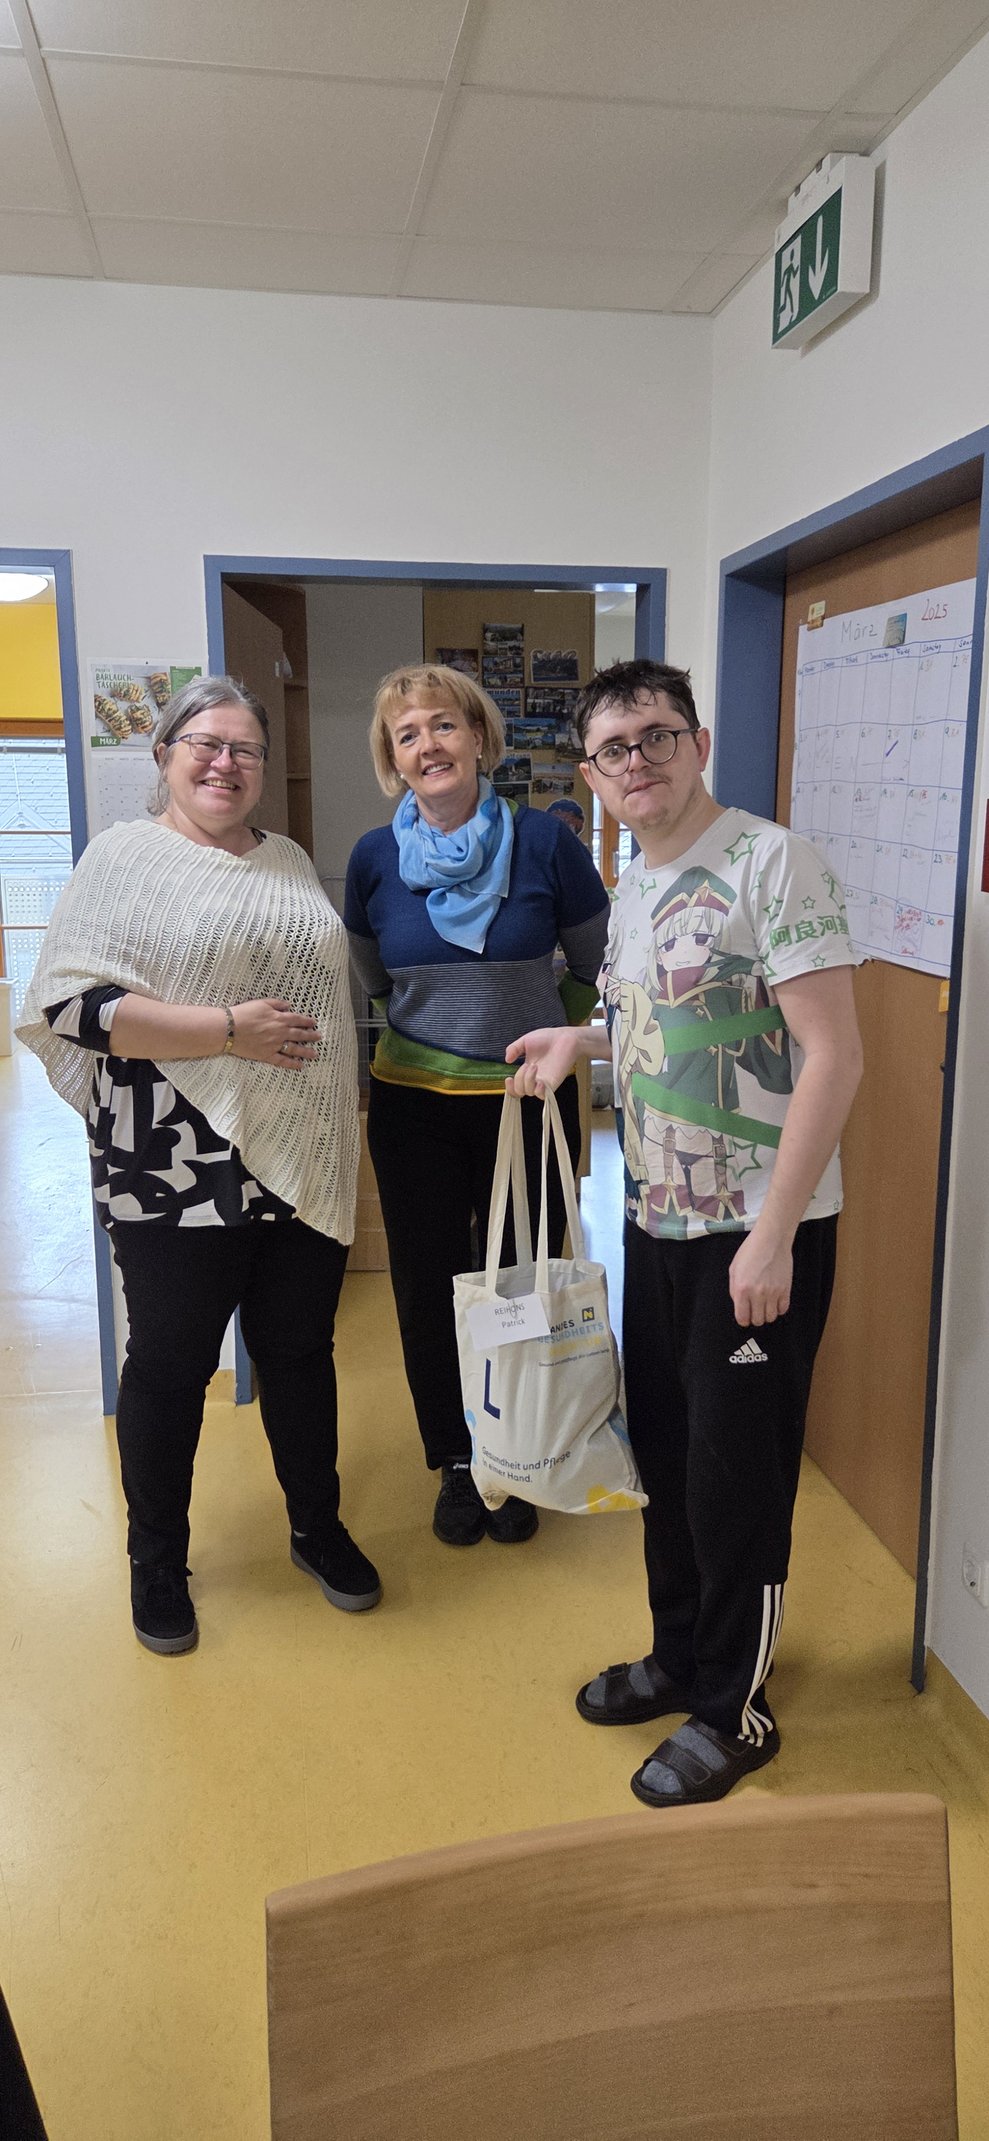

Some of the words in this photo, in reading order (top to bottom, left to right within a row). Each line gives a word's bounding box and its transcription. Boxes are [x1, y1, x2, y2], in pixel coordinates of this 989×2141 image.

[921, 599, 948, 621] 2025
[501, 1318, 526, 1329] Patrick
[728, 1353, 768, 1364] adidas
[482, 1446, 521, 1471] Gesundheit
[522, 1461, 541, 1471] und
[507, 1471, 533, 1483] Hand.
